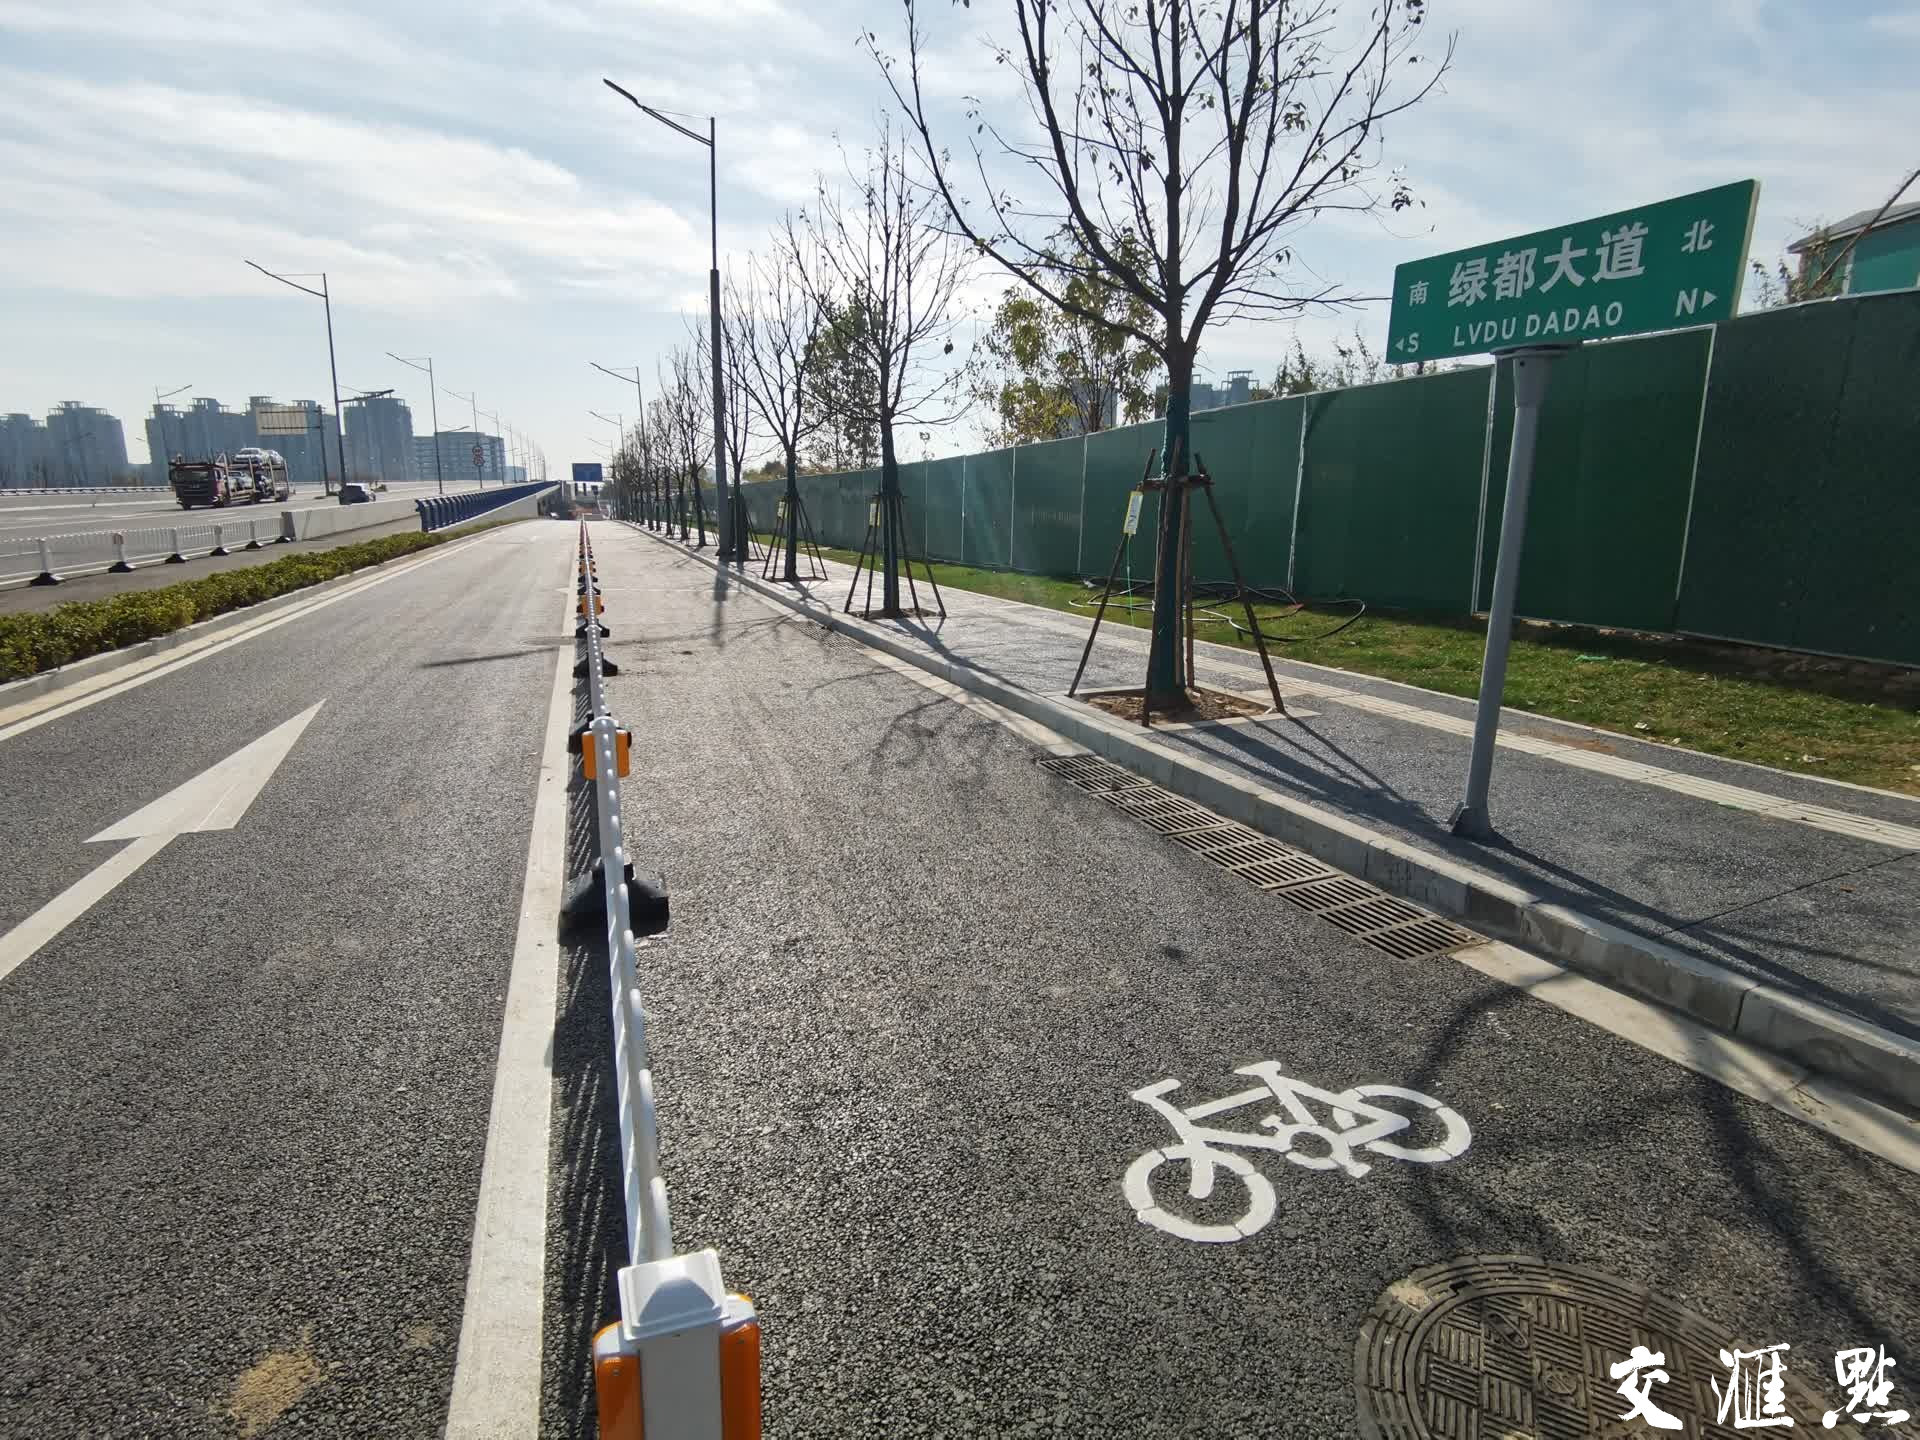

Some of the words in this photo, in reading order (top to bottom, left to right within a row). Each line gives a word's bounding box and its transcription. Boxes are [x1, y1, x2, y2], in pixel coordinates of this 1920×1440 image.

[1682, 220, 1715, 253] 北
[1447, 222, 1649, 307] 绿都大道
[1409, 280, 1429, 306] 南
[1675, 288, 1699, 317] N
[1454, 317, 1516, 347] LVDU
[1525, 301, 1624, 337] DADAO
[1408, 333, 1420, 353] S
